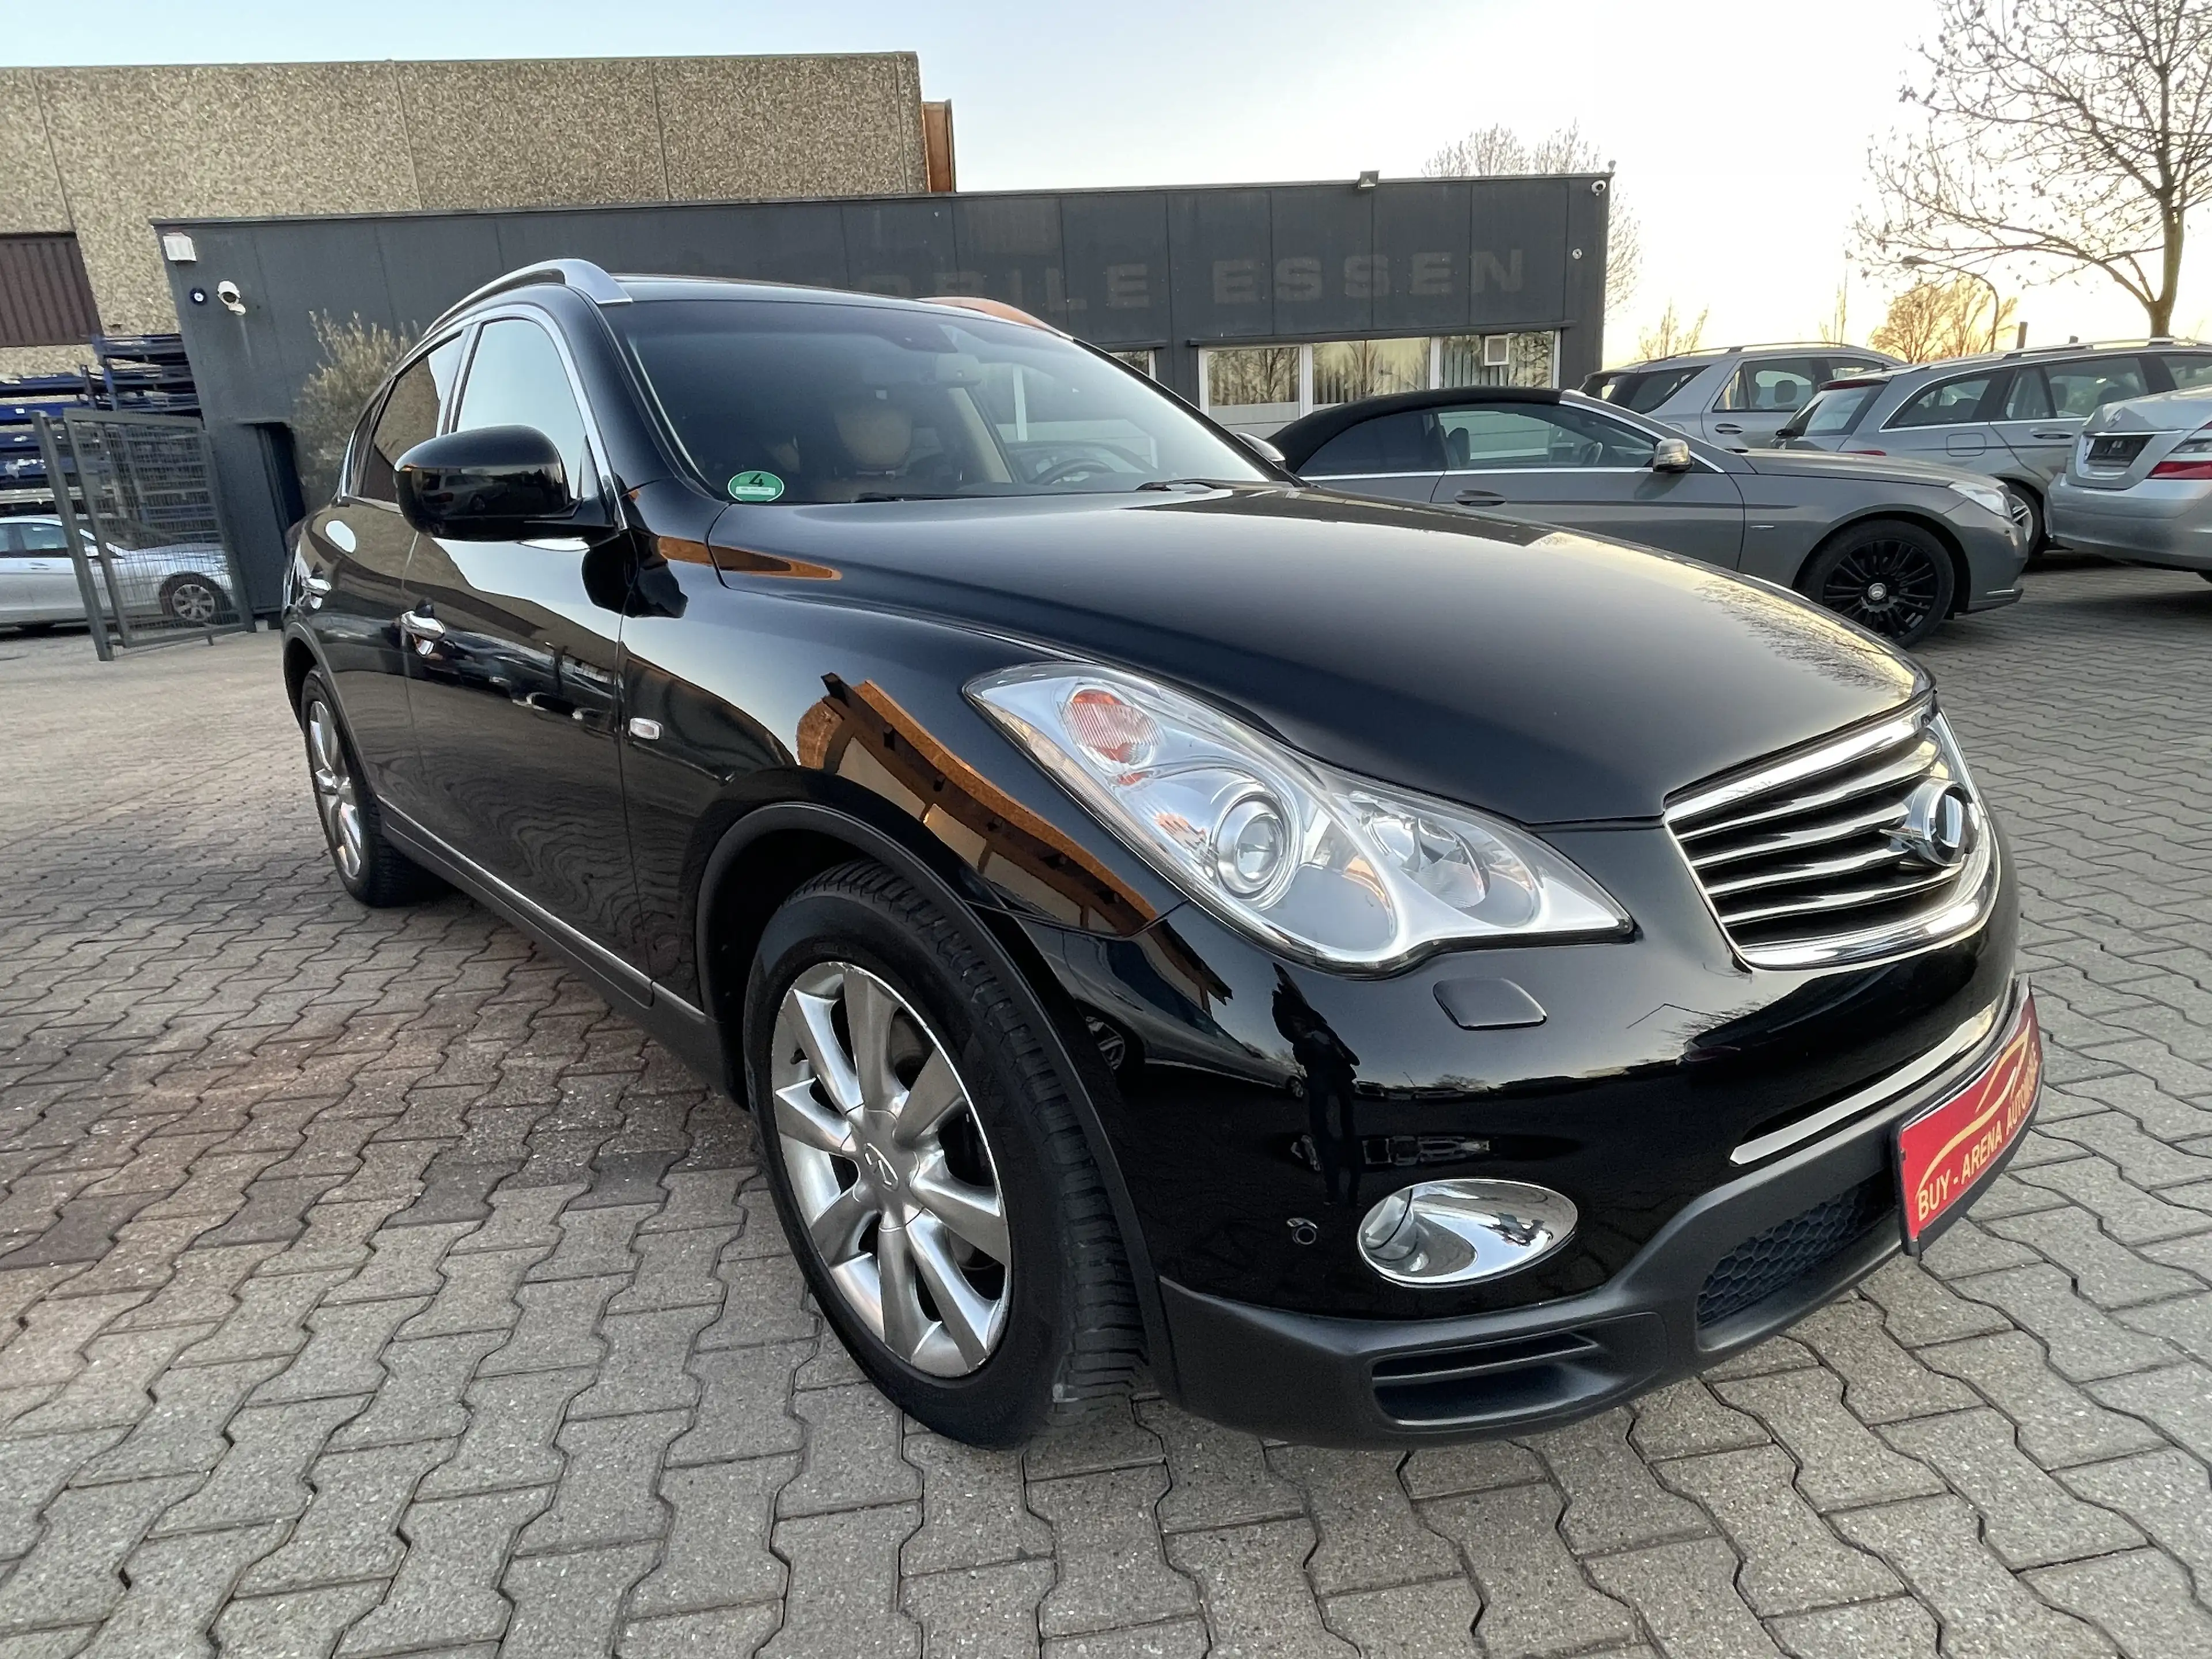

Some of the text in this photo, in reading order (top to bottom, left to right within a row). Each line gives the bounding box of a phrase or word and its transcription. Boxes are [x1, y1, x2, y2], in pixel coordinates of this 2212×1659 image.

[1213, 249, 1524, 304] ESSEN
[749, 473, 764, 487] 4
[1918, 1169, 1950, 1221] BUY
[1961, 1120, 2002, 1185] ARENA
